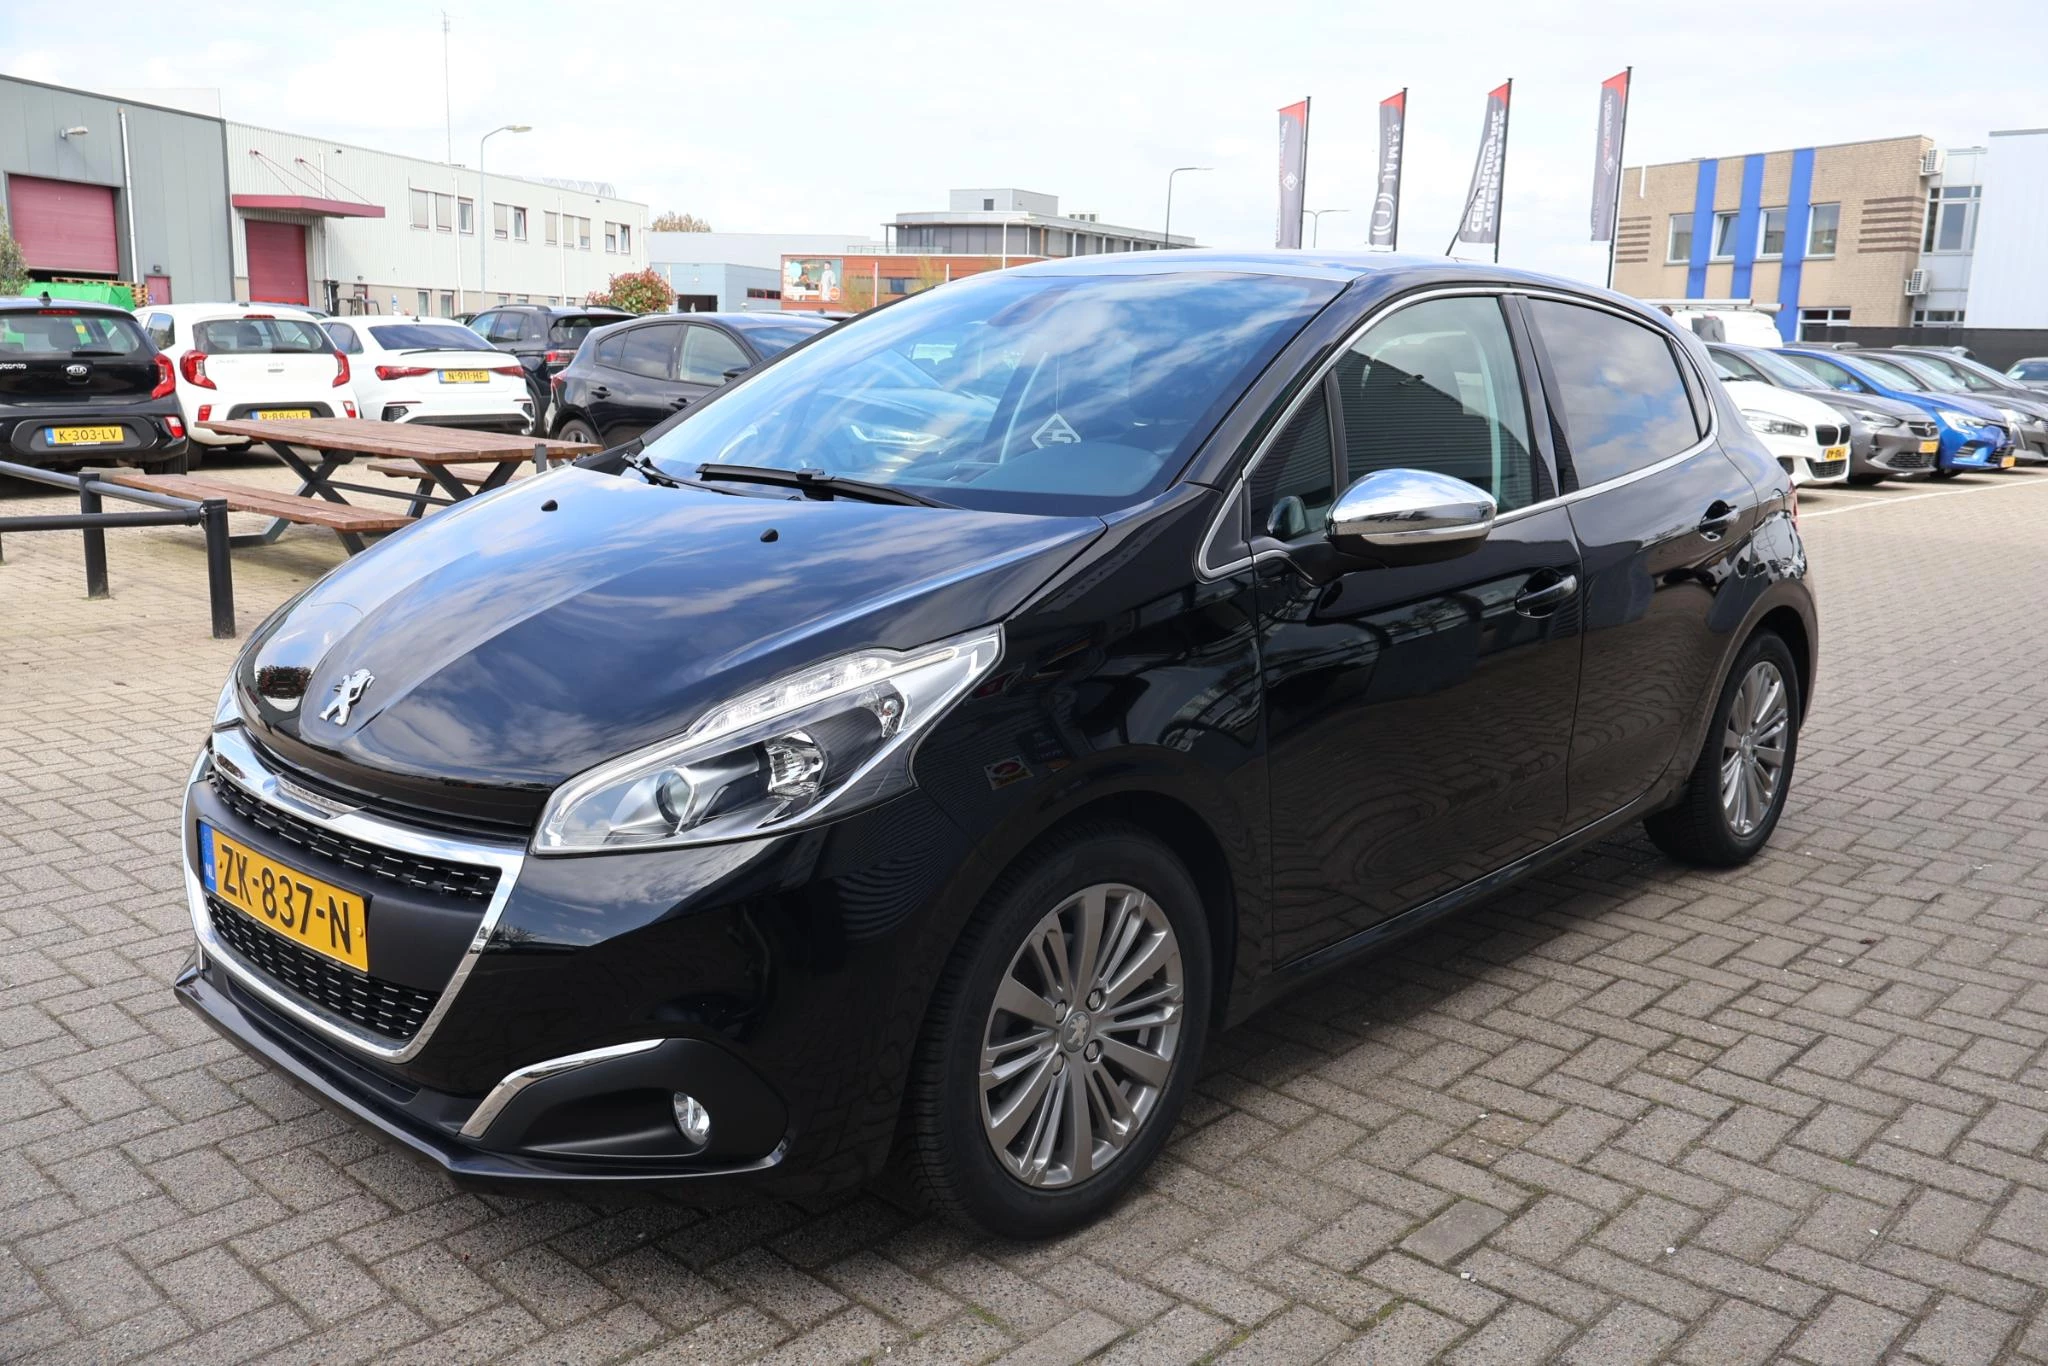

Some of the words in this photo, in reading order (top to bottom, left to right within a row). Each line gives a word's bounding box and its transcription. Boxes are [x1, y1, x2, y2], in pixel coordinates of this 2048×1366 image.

[58, 428, 117, 441] K-303-LV
[205, 862, 215, 880] NL
[221, 844, 352, 954] ZK-837-N
